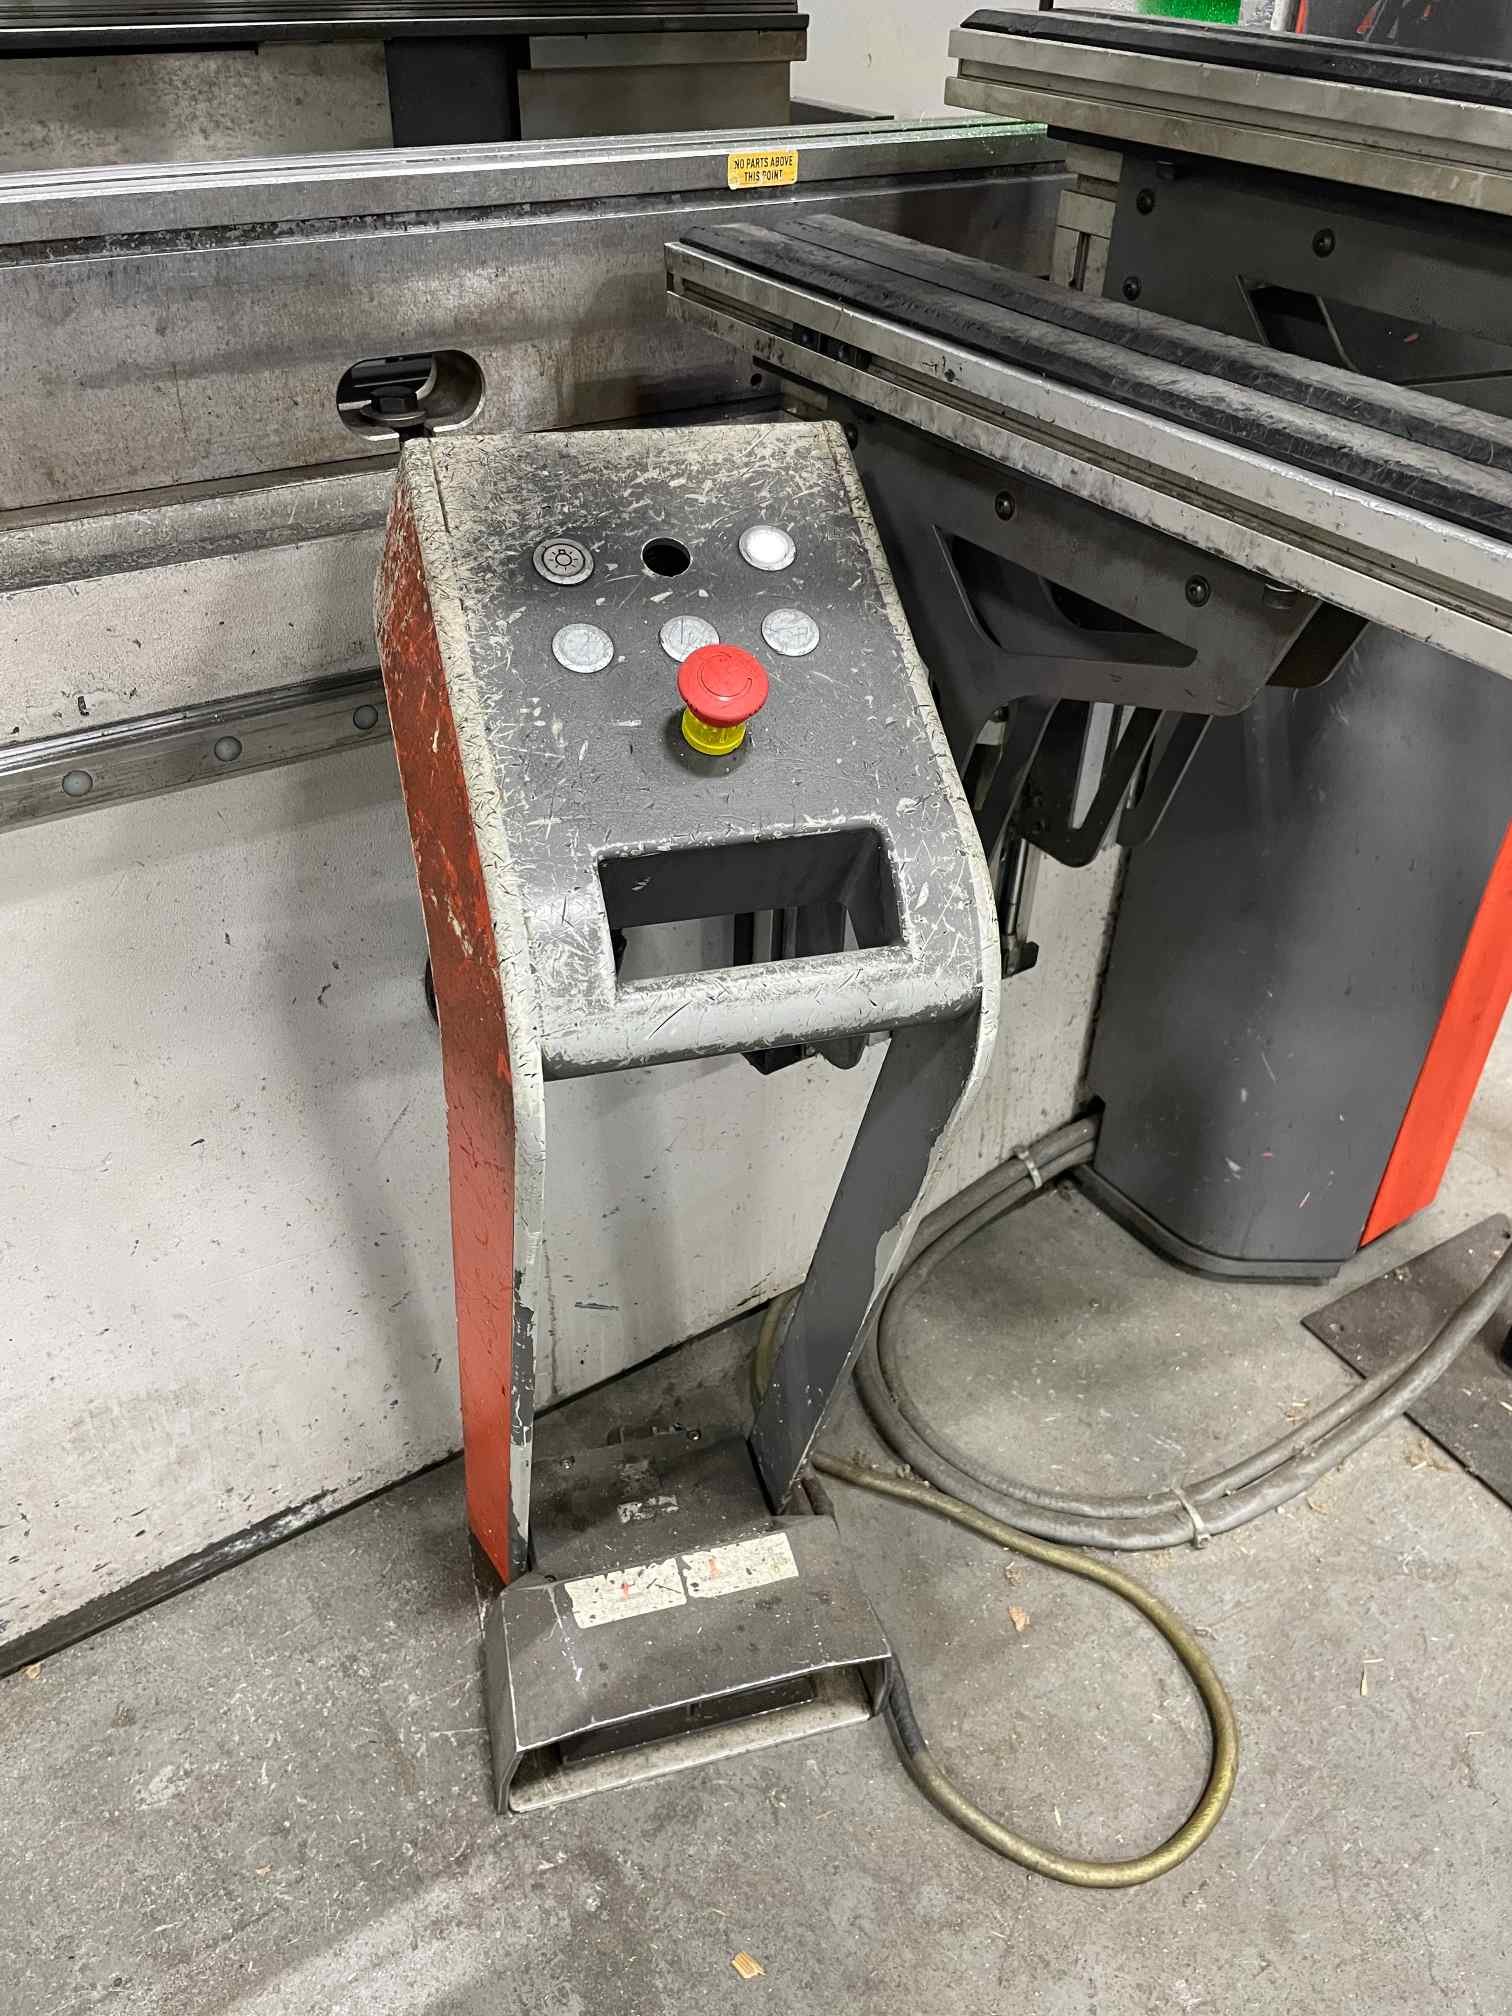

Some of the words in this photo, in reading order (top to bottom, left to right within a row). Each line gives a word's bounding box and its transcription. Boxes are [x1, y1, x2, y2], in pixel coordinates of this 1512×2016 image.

[734, 158, 745, 170] NO
[746, 157, 769, 168] PARTS
[770, 155, 793, 167] ABOVE
[744, 171, 760, 182] THIS
[762, 170, 782, 181] POINT
